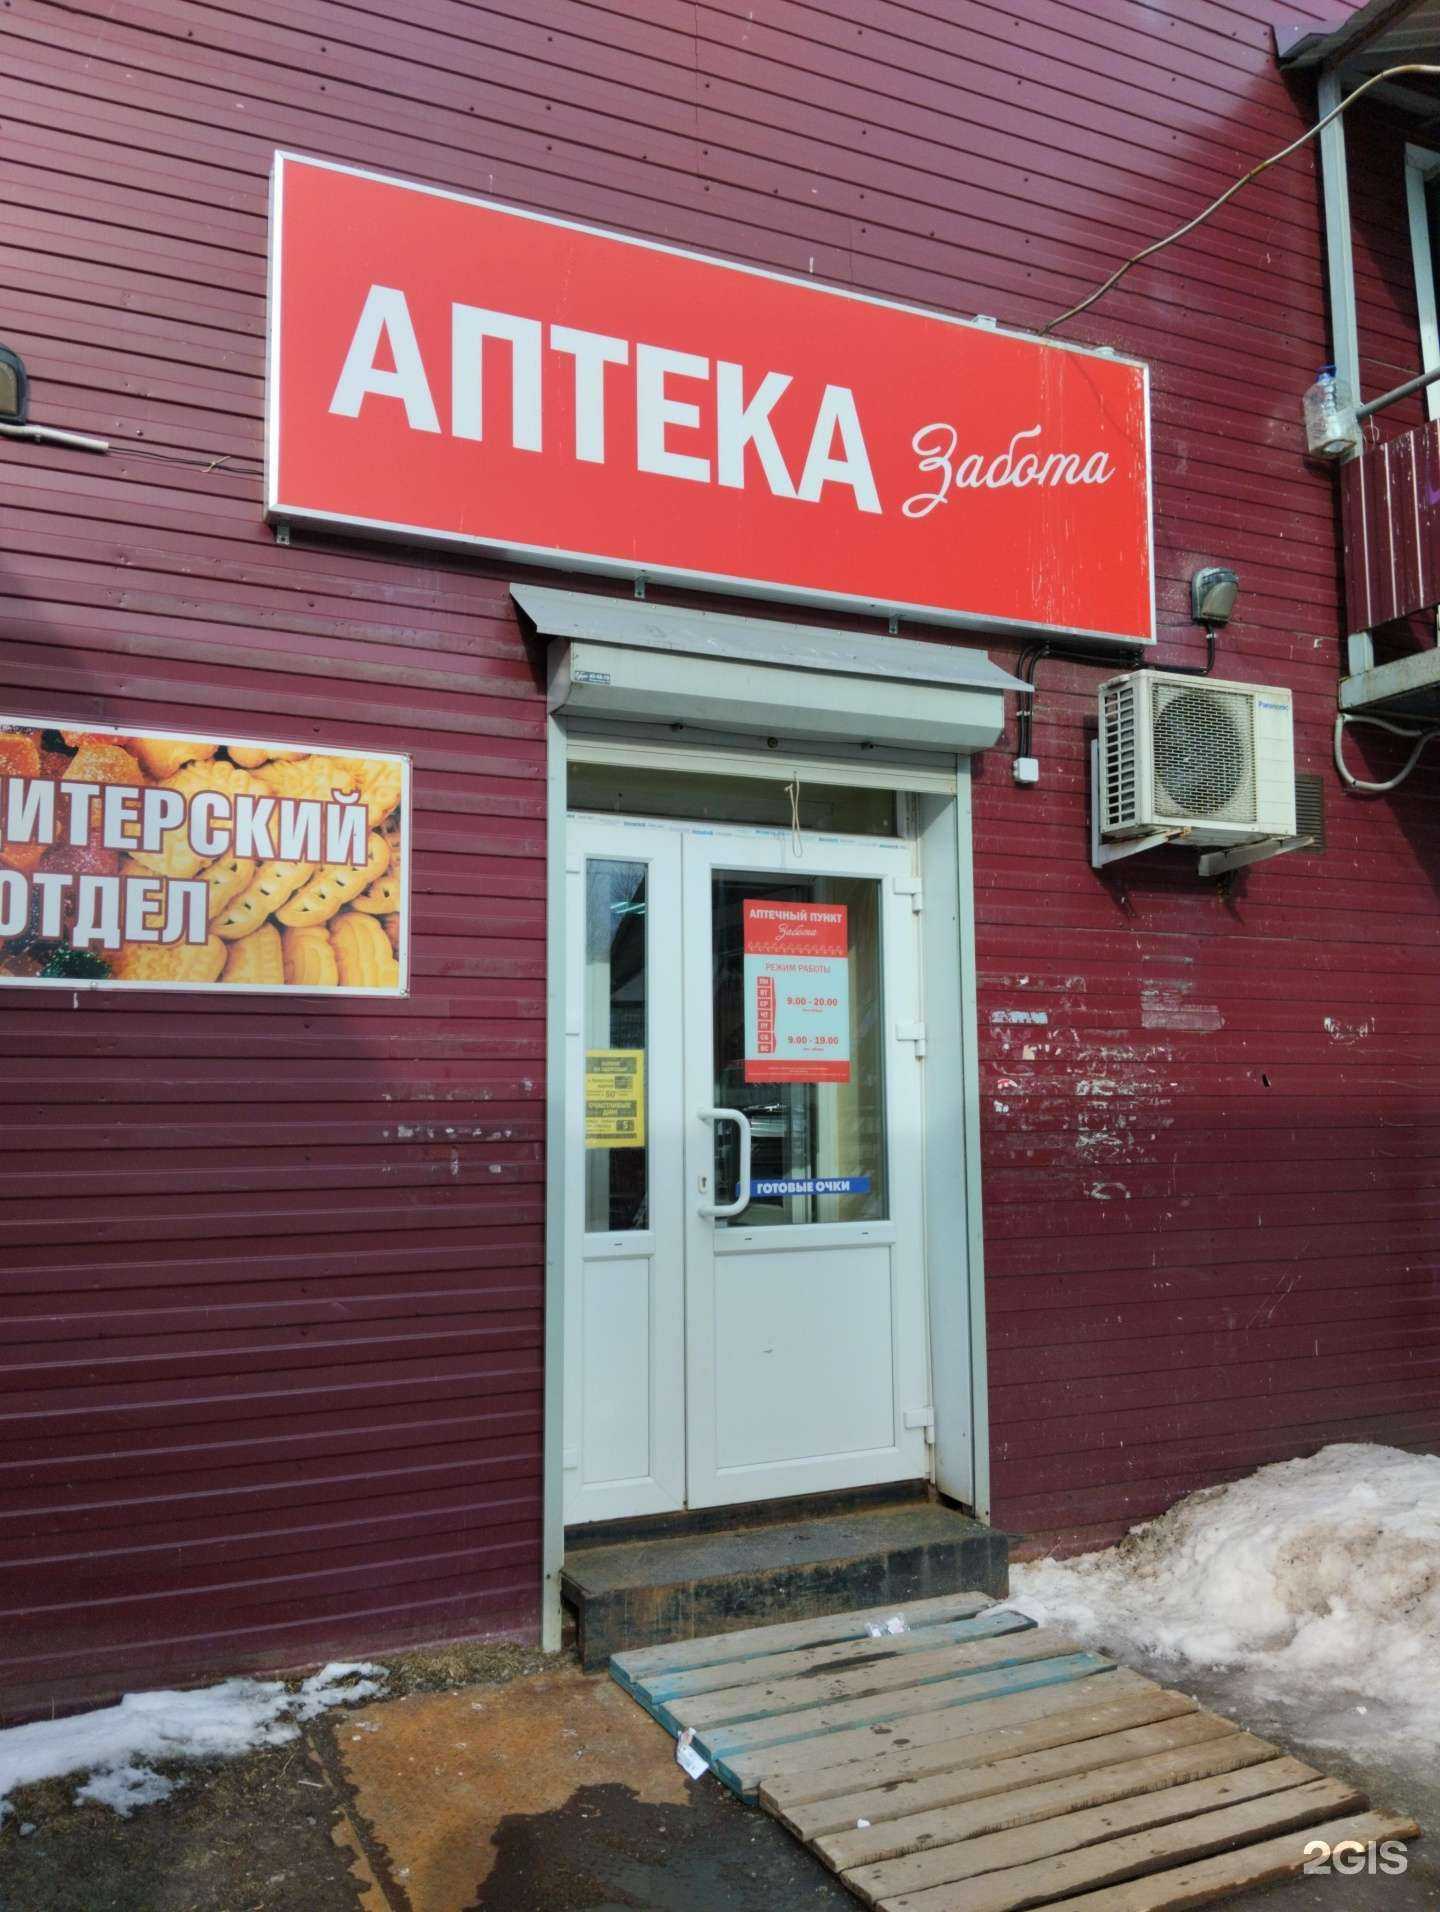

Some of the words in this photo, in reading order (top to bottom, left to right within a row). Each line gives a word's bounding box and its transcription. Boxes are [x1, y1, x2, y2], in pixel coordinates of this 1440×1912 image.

[328, 284, 882, 514] АПТЕКА
[902, 423, 1116, 518] Забота
[0, 777, 367, 865] ИТЕРСКИЙ
[0, 870, 207, 949] ОТДЕЛ
[750, 909, 807, 921] АПТЕЧНЫЙ
[810, 912, 842, 923] ПУНКТ
[766, 963, 797, 972] РЕЖИМ
[799, 965, 831, 974] РАБОТЫ
[786, 997, 807, 1006] 9.00
[814, 998, 838, 1007] 20.00
[787, 1036, 808, 1045] 9.00
[815, 1037, 839, 1046] 19.00
[757, 1182, 814, 1194] ГОТОВЫЕ
[815, 1180, 851, 1191] ОЧКИ
